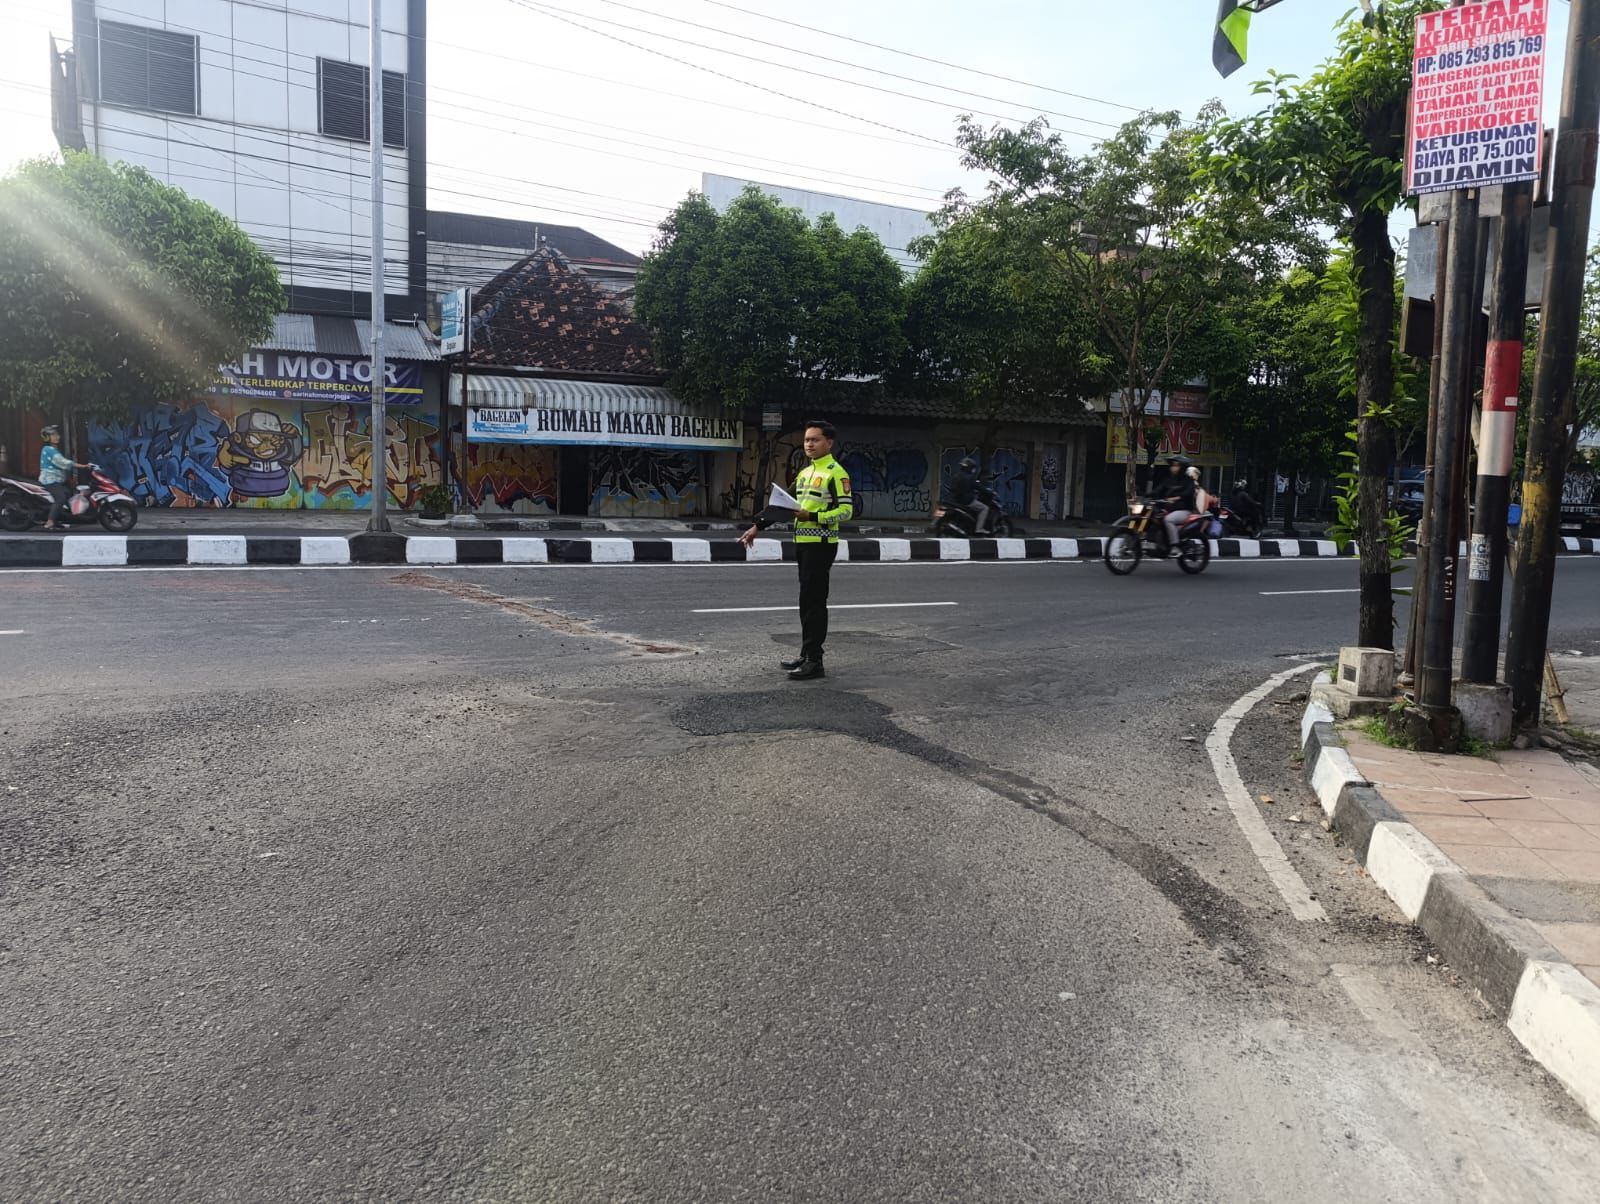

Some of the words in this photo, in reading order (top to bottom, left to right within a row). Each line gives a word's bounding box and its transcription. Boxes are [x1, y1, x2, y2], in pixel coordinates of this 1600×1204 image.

[1420, 9, 1544, 47] KEJANTANAN
[1417, 57, 1437, 74] HP:
[1439, 51, 1463, 70] 085
[1465, 45, 1490, 64] 293
[1492, 40, 1516, 59] 815
[1519, 35, 1542, 55] 769
[1416, 86, 1443, 100] OTOT
[1445, 79, 1479, 95] SARAF
[1481, 73, 1508, 89] ALAT
[1509, 68, 1540, 83] VITAL
[1417, 55, 1541, 87] MENGENCANGKAN
[1416, 91, 1478, 113] TAHAN
[1483, 81, 1539, 102] LAMA
[1493, 96, 1538, 112] PANJANG
[1415, 108, 1538, 139] VARIKOKEL
[1415, 122, 1537, 152] KETURUNAN
[1414, 149, 1455, 170] BIAYA
[1459, 145, 1479, 163] RP.
[1483, 137, 1536, 160] 75.000
[1413, 157, 1535, 187] DIJAMIN
[277, 355, 398, 384] MOTOR
[240, 378, 305, 389] TERLENGKAP
[307, 381, 370, 393] TERPERCAYA
[480, 409, 521, 423] BAGELEN
[537, 409, 602, 433] RUMAH
[607, 411, 666, 436] MAKAN
[671, 415, 738, 440] BAGELEN
